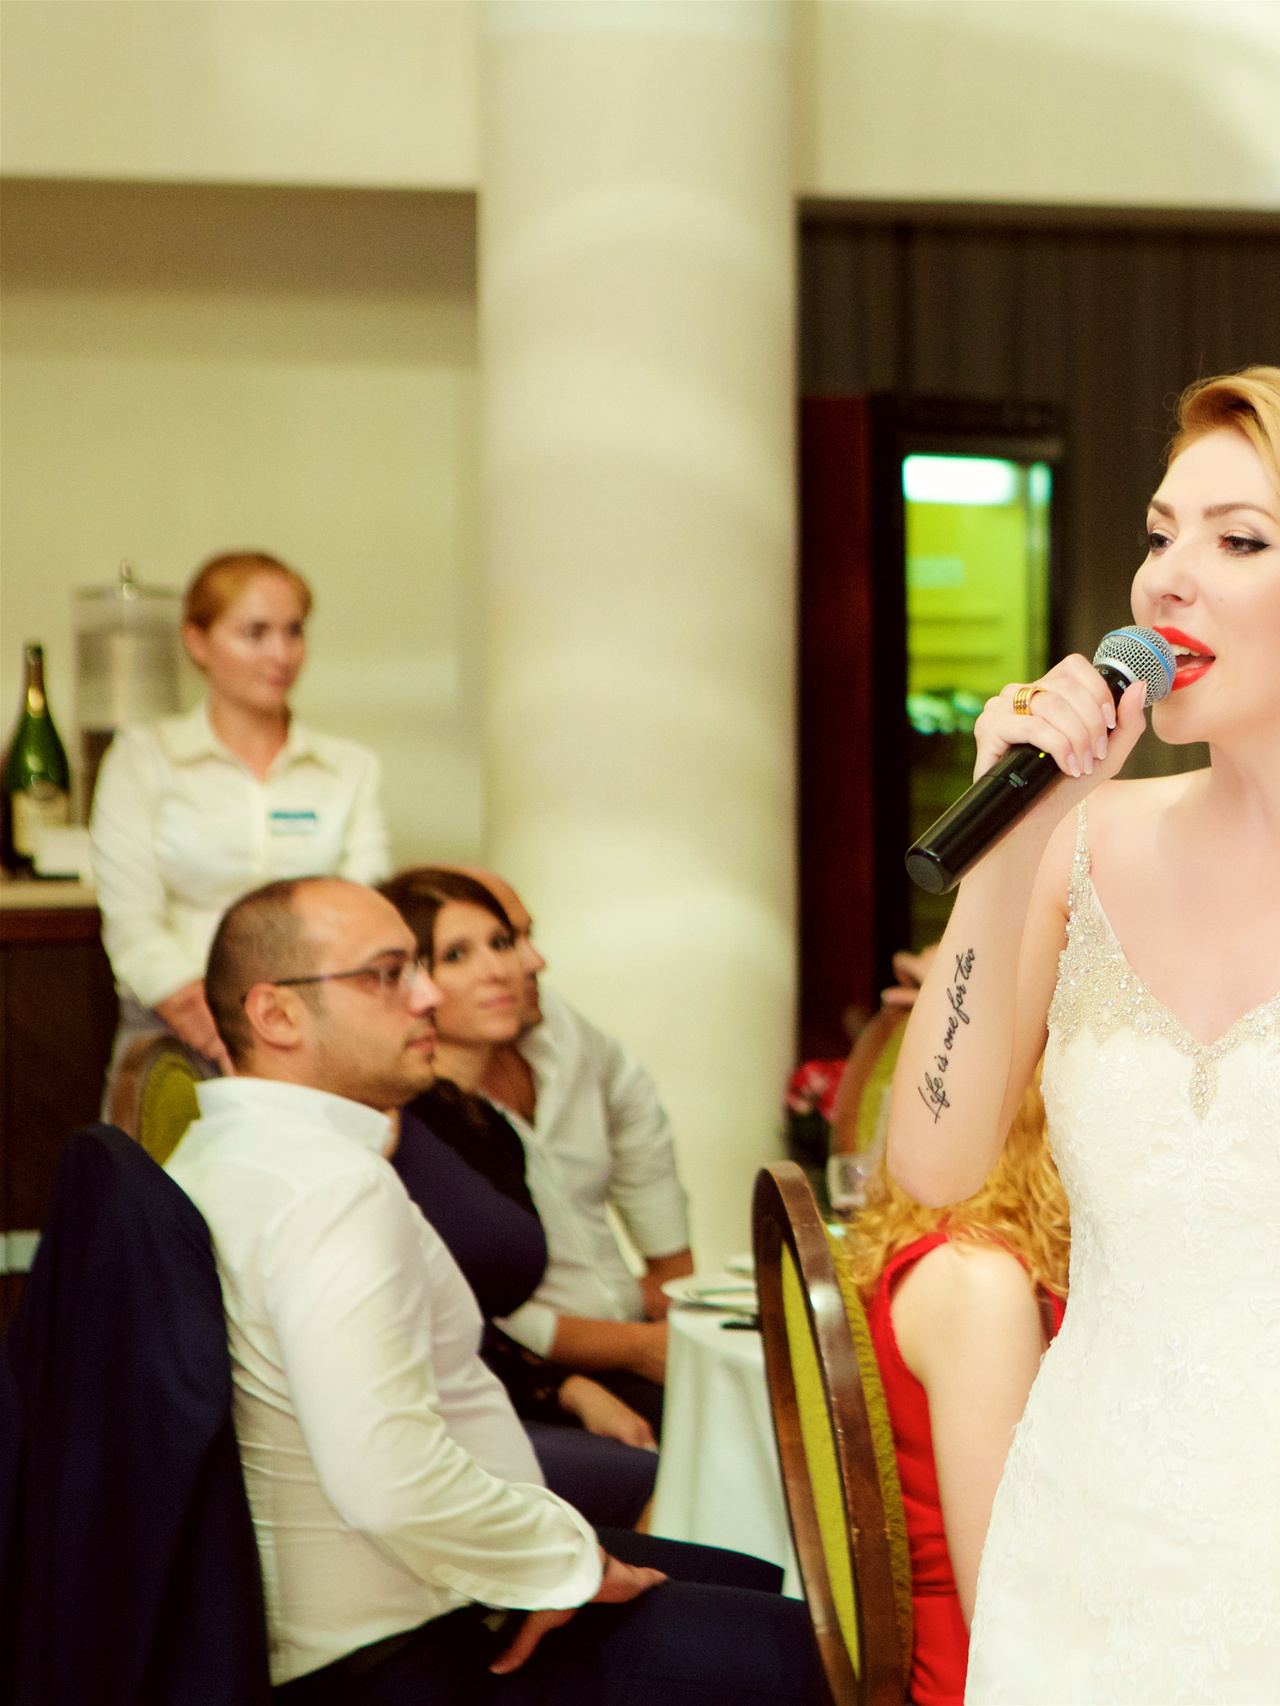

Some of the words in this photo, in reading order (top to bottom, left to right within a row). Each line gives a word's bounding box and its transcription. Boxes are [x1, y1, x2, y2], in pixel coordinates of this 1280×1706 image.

[953, 947, 976, 983] two
[946, 984, 970, 1025] for
[943, 1016, 958, 1051] one
[934, 1054, 949, 1073] is
[918, 1071, 950, 1125] Life
